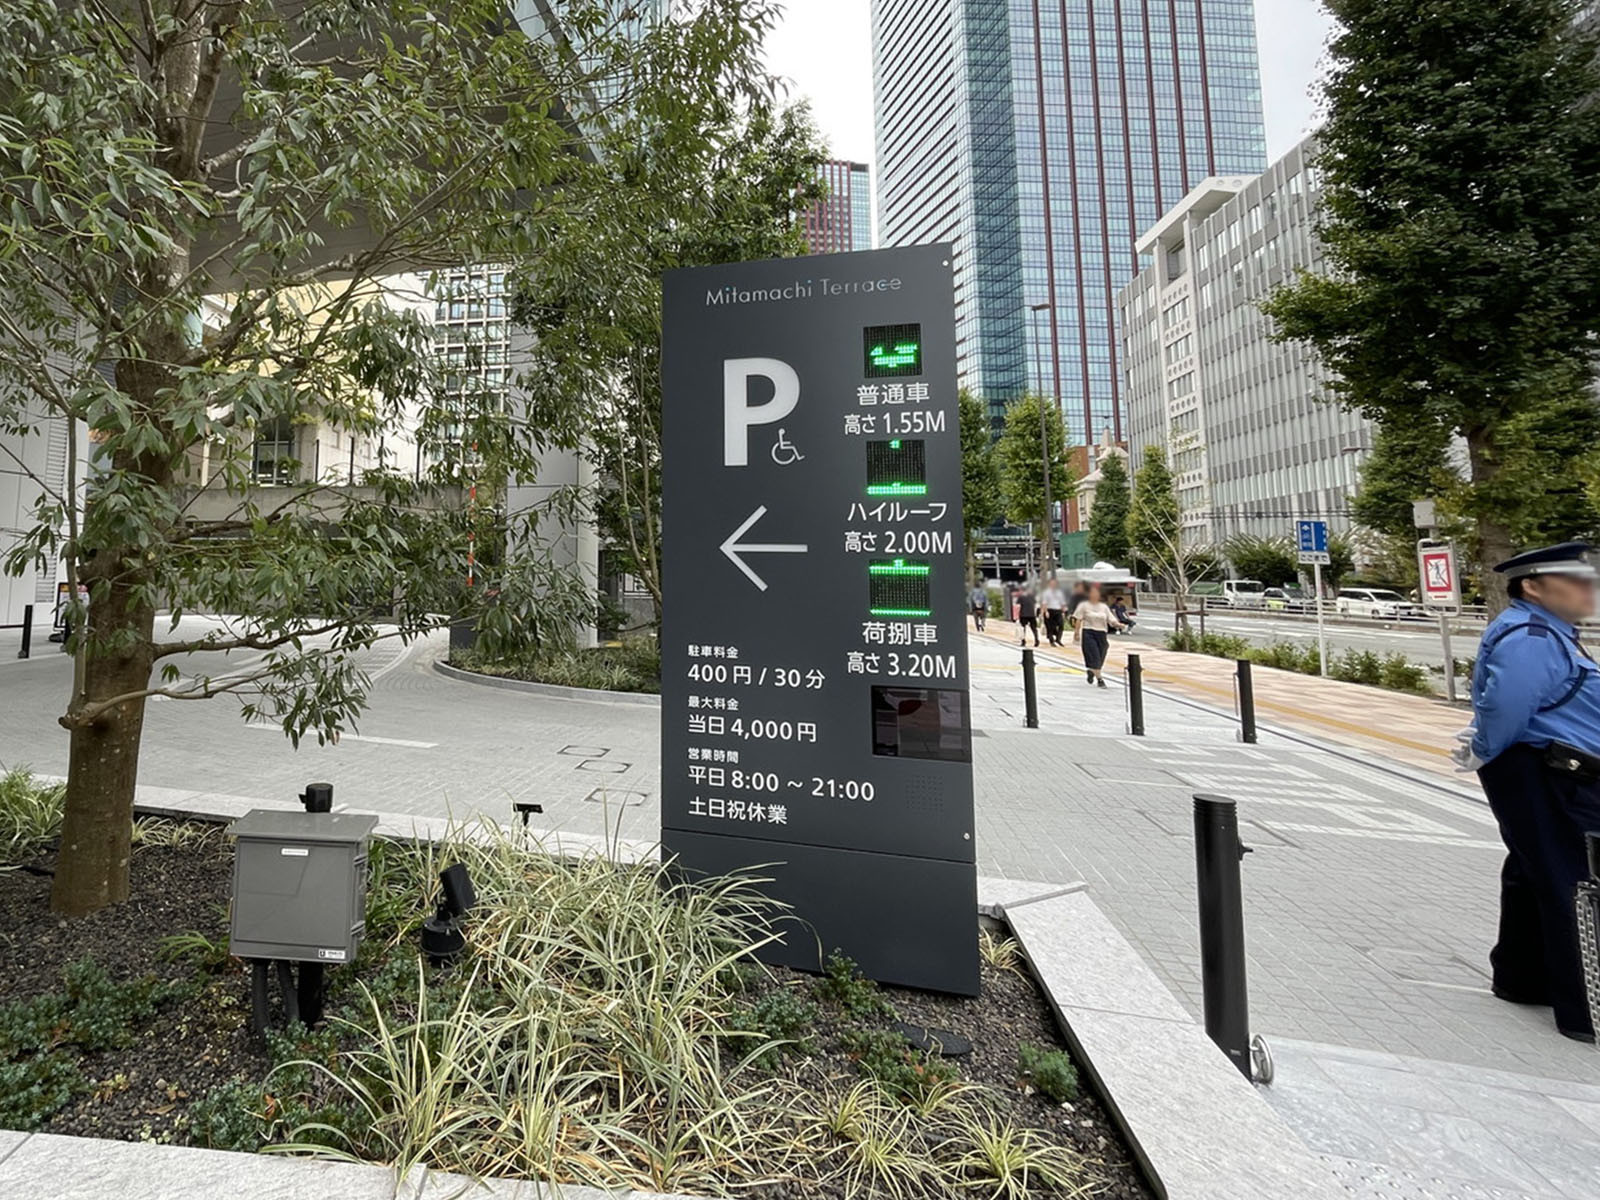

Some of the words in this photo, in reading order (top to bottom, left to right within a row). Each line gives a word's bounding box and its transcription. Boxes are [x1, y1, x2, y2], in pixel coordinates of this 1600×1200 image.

[706, 279, 813, 306] Mitamachi
[820, 278, 902, 296] Terrace
[856, 381, 930, 406] 普通車
[723, 357, 801, 467] P
[843, 413, 877, 435] 高さ
[882, 409, 946, 434] 1.55M
[847, 501, 948, 522] ハイルーフ
[844, 530, 878, 553] 高さ
[884, 530, 953, 554] 2.00M
[862, 621, 939, 646] 荷捌車
[687, 644, 739, 659] 駐車料金
[846, 650, 882, 675] 高さ
[887, 652, 957, 679] 3.20M
[687, 695, 739, 711] 最大料金
[687, 747, 739, 764] 営業時間
[688, 765, 725, 788] 平日
[731, 770, 779, 792] 8:00
[811, 777, 875, 802] 21:00
[688, 798, 788, 825] 土日祝休業
